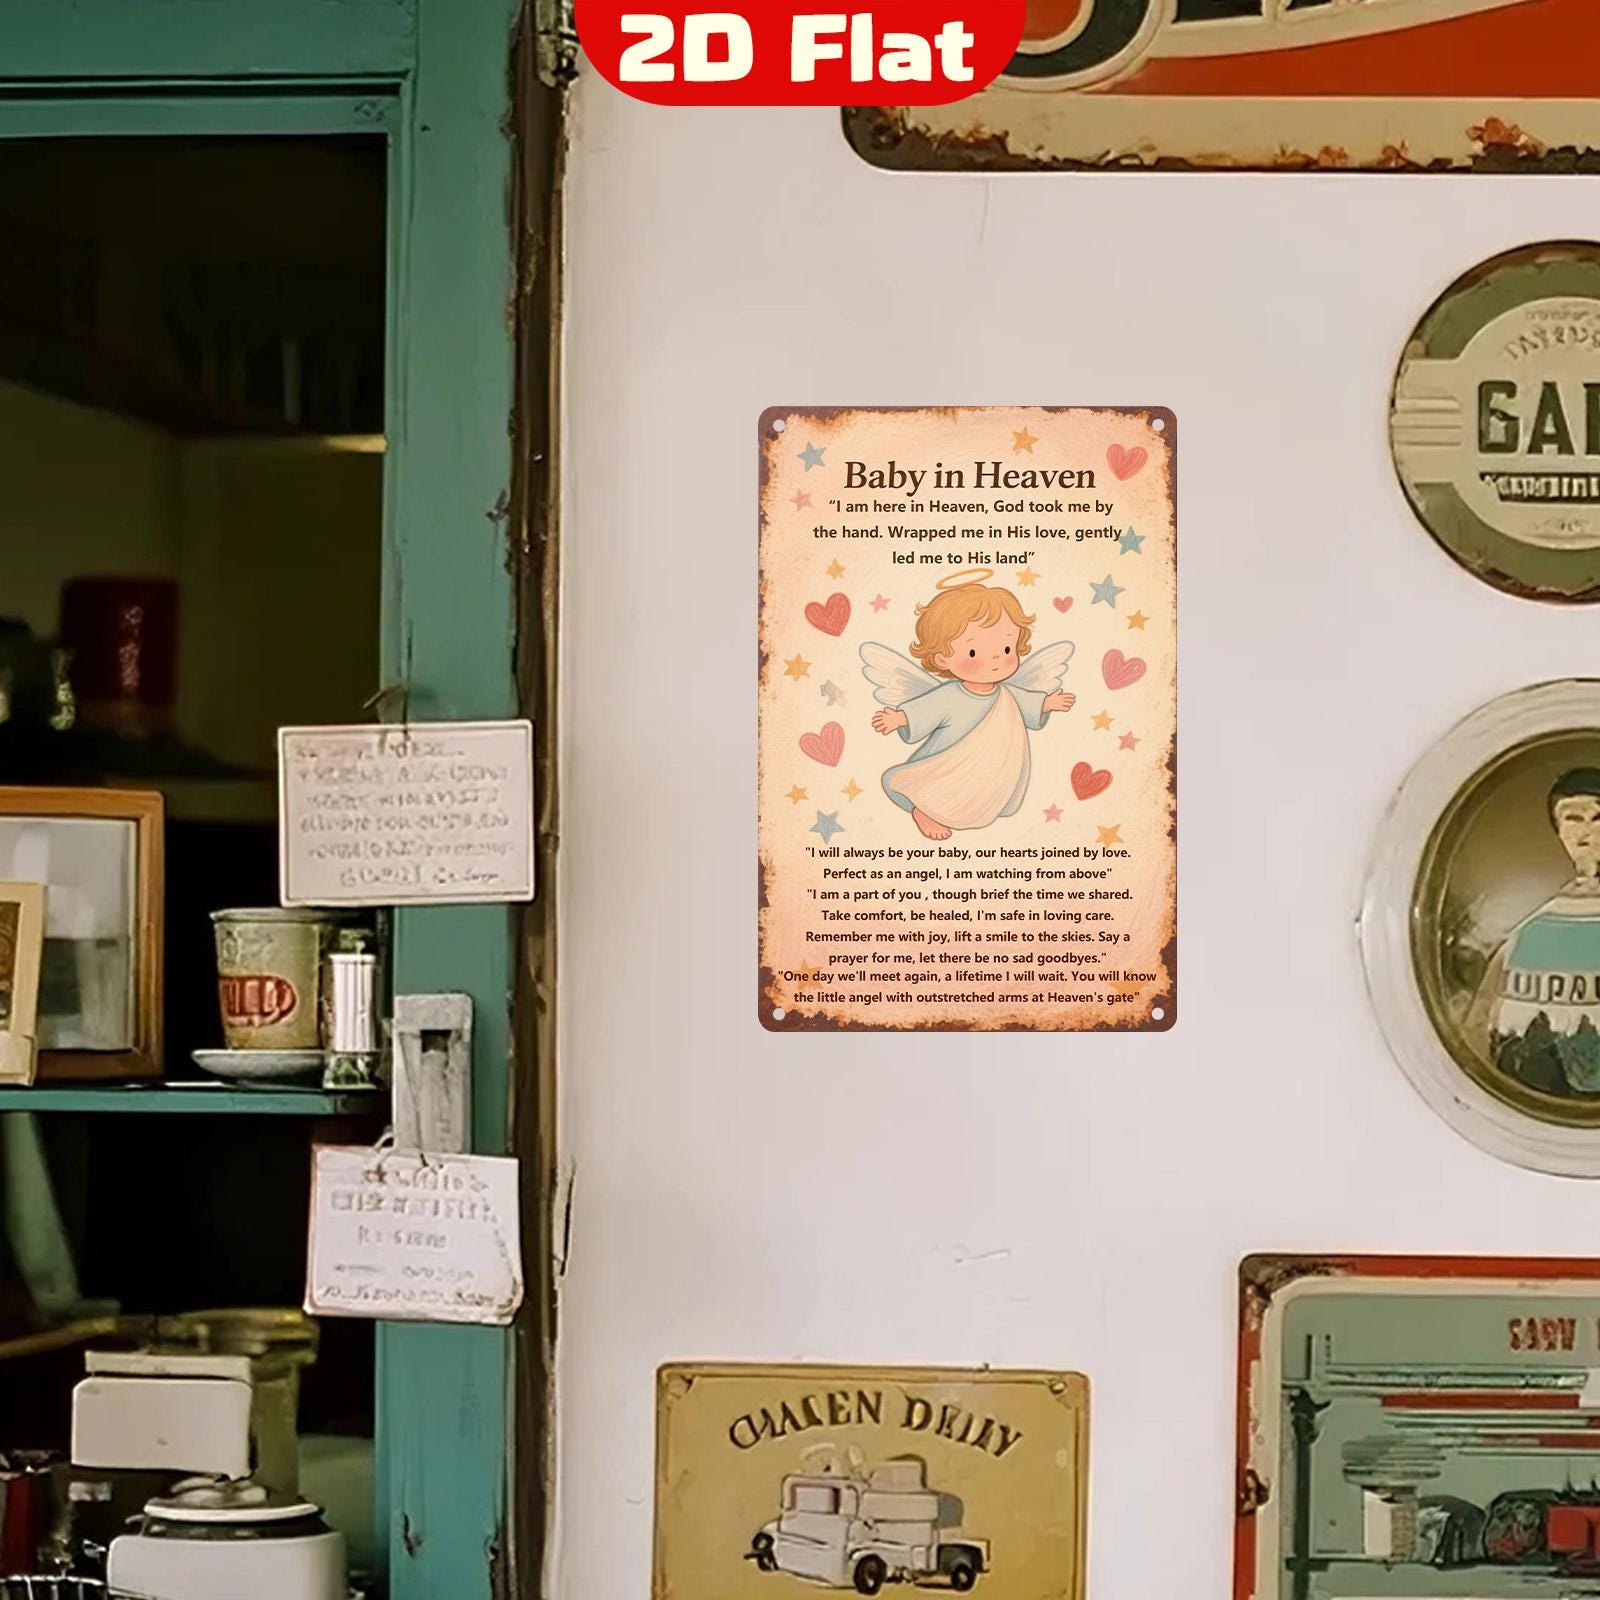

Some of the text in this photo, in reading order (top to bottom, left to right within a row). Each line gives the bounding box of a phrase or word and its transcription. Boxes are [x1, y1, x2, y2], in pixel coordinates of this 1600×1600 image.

[844, 461, 1096, 497] Baby in Heaven
[846, 503, 868, 512] am
[874, 500, 906, 512] here
[911, 500, 924, 512] in
[930, 500, 988, 514] Heaven,
[994, 500, 1024, 512] God
[1029, 500, 1063, 512] took
[1068, 503, 1090, 512] me
[1096, 500, 1113, 515] by
[813, 525, 1122, 542] the hand. Wrapped me in His love, gently
[893, 551, 914, 564] led
[920, 555, 942, 564] me
[947, 553, 963, 564] to
[968, 551, 991, 564] His
[819, 847, 839, 858] will
[843, 847, 884, 861] always
[888, 847, 903, 858] be
[907, 850, 935, 861] your
[938, 847, 971, 861] baby,
[975, 850, 996, 858] our
[1000, 847, 1038, 858] hearts
[1040, 847, 1079, 860] joined
[1084, 847, 1098, 861] by
[1102, 847, 1131, 858] love.
[824, 868, 867, 879] Perfect
[870, 871, 883, 879] as
[887, 871, 902, 879] an
[905, 868, 942, 881] angel,
[946, 868, 950, 879] I
[954, 871, 972, 879] am
[976, 868, 1032, 881] watching
[1036, 868, 1066, 879] from
[820, 891, 839, 899] am
[843, 891, 850, 899] a
[854, 890, 879, 902] part
[882, 888, 896, 899] of
[899, 891, 921, 902] you
[932, 889, 977, 902] though
[981, 888, 1010, 899] brief
[1013, 889, 1033, 899] the
[1036, 889, 1064, 899] time
[1067, 892, 1085, 900] we
[1089, 889, 1133, 900] shared.
[821, 910, 1114, 923] Take comfort, be healed, I'm safe in loving care.
[806, 931, 1130, 945] Remember me with joy, lift a smile to the skies. Say a
[829, 955, 868, 966] prayer
[872, 952, 890, 963] for
[894, 955, 915, 964] me,
[919, 952, 935, 963] let
[938, 952, 971, 963] there
[975, 952, 989, 963] be
[993, 955, 1009, 963] no
[1013, 952, 1033, 963] sad
[812, 970, 835, 984] day
[837, 970, 866, 981] we'll
[870, 972, 901, 981] meet
[904, 970, 941, 984] again,
[945, 973, 952, 981] a
[956, 970, 1002, 981] lifetime
[1005, 971, 1010, 981] I
[1013, 970, 1034, 981] will
[1038, 970, 1068, 981] wait.
[1071, 971, 1095, 981] You
[1098, 970, 1119, 981] will
[1123, 970, 1157, 982] know
[793, 991, 814, 1003] the
[817, 991, 846, 1003] little
[849, 992, 882, 1005] angel
[886, 992, 912, 1002] with
[916, 991, 994, 1003] outstretched
[998, 994, 1029, 1003] arms
[1032, 993, 1044, 1003] at
[1048, 992, 1103, 1003] Heaven's
